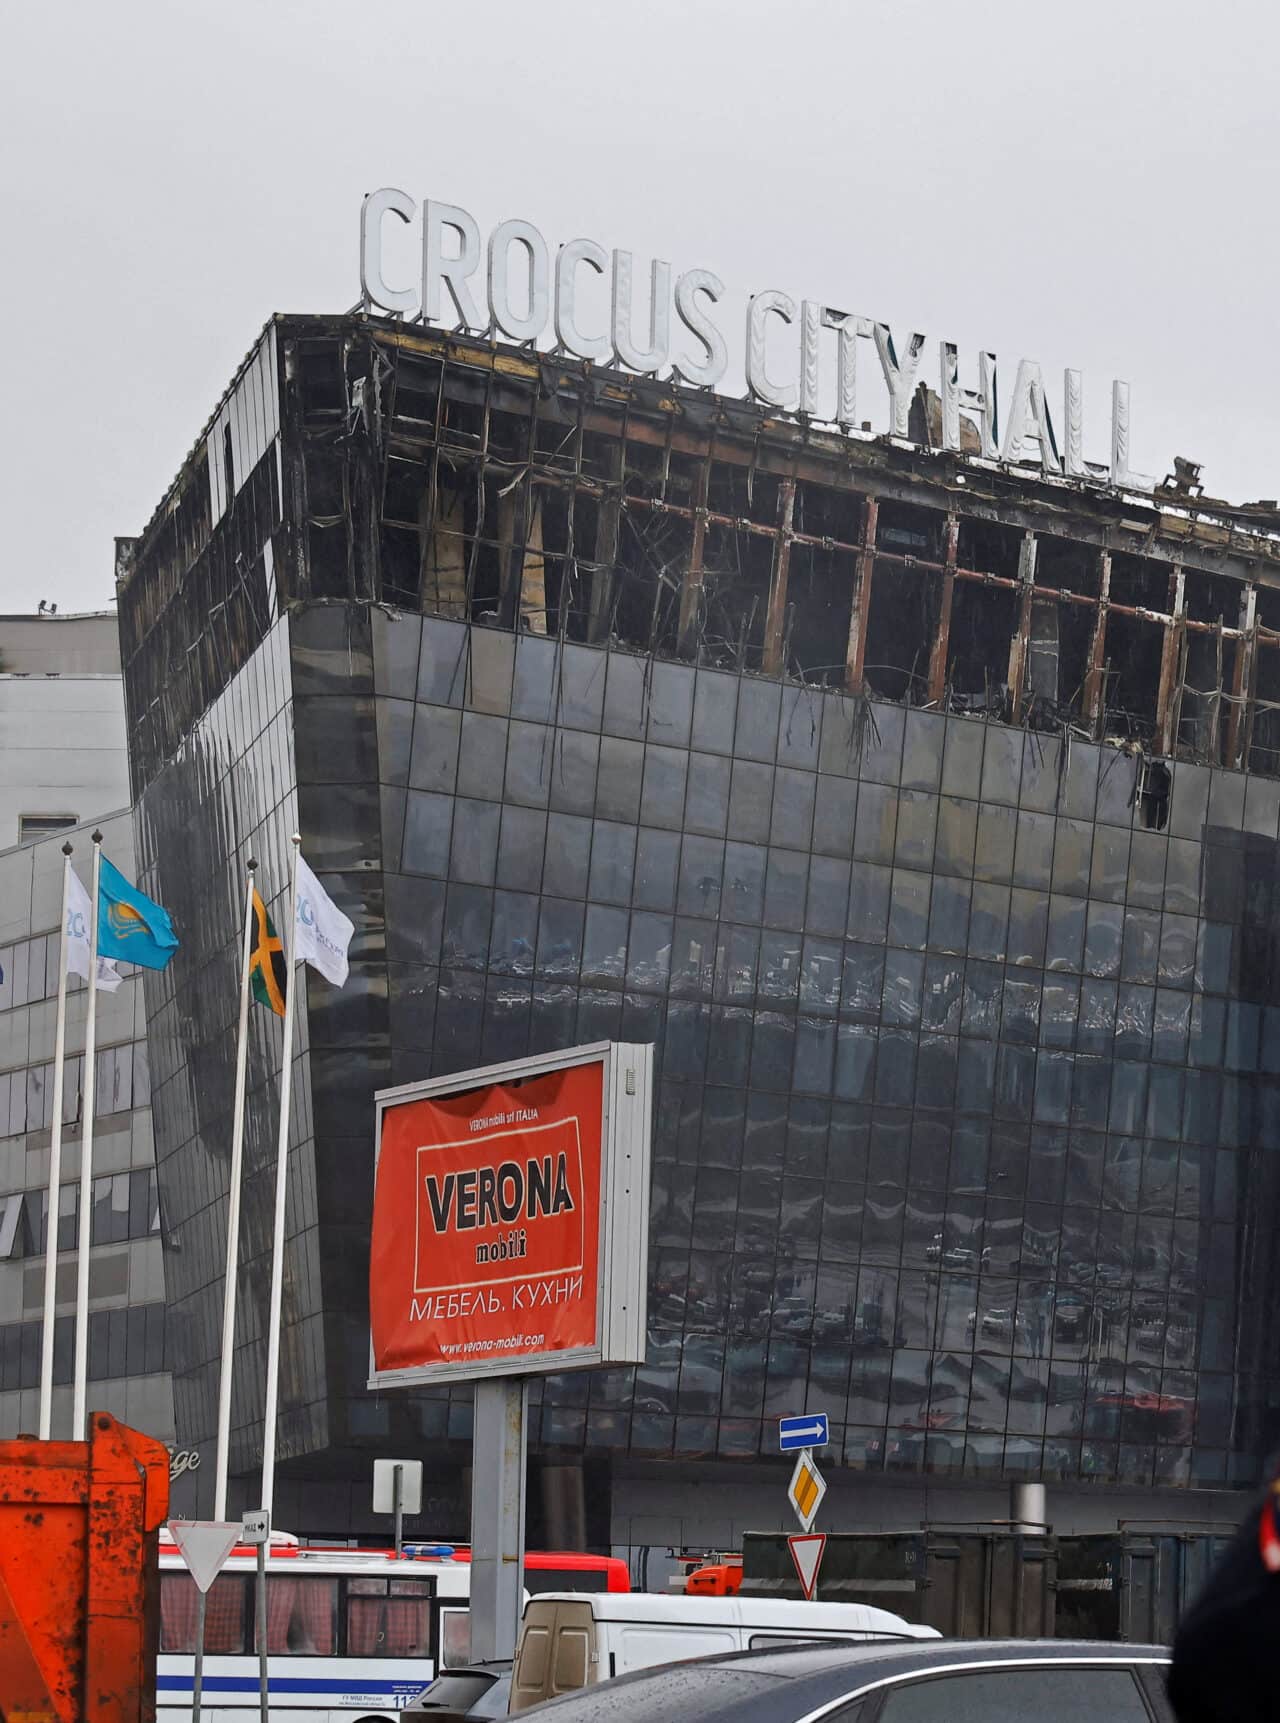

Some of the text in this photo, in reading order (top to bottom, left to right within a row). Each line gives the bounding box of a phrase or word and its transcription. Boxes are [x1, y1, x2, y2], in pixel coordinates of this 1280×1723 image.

[360, 187, 1158, 493] CROCUS CITY HALL
[516, 1108, 538, 1122] ITALIA
[425, 1152, 575, 1234] VERONA
[476, 1229, 527, 1264] mobili
[512, 1275, 583, 1310] КУХНИ
